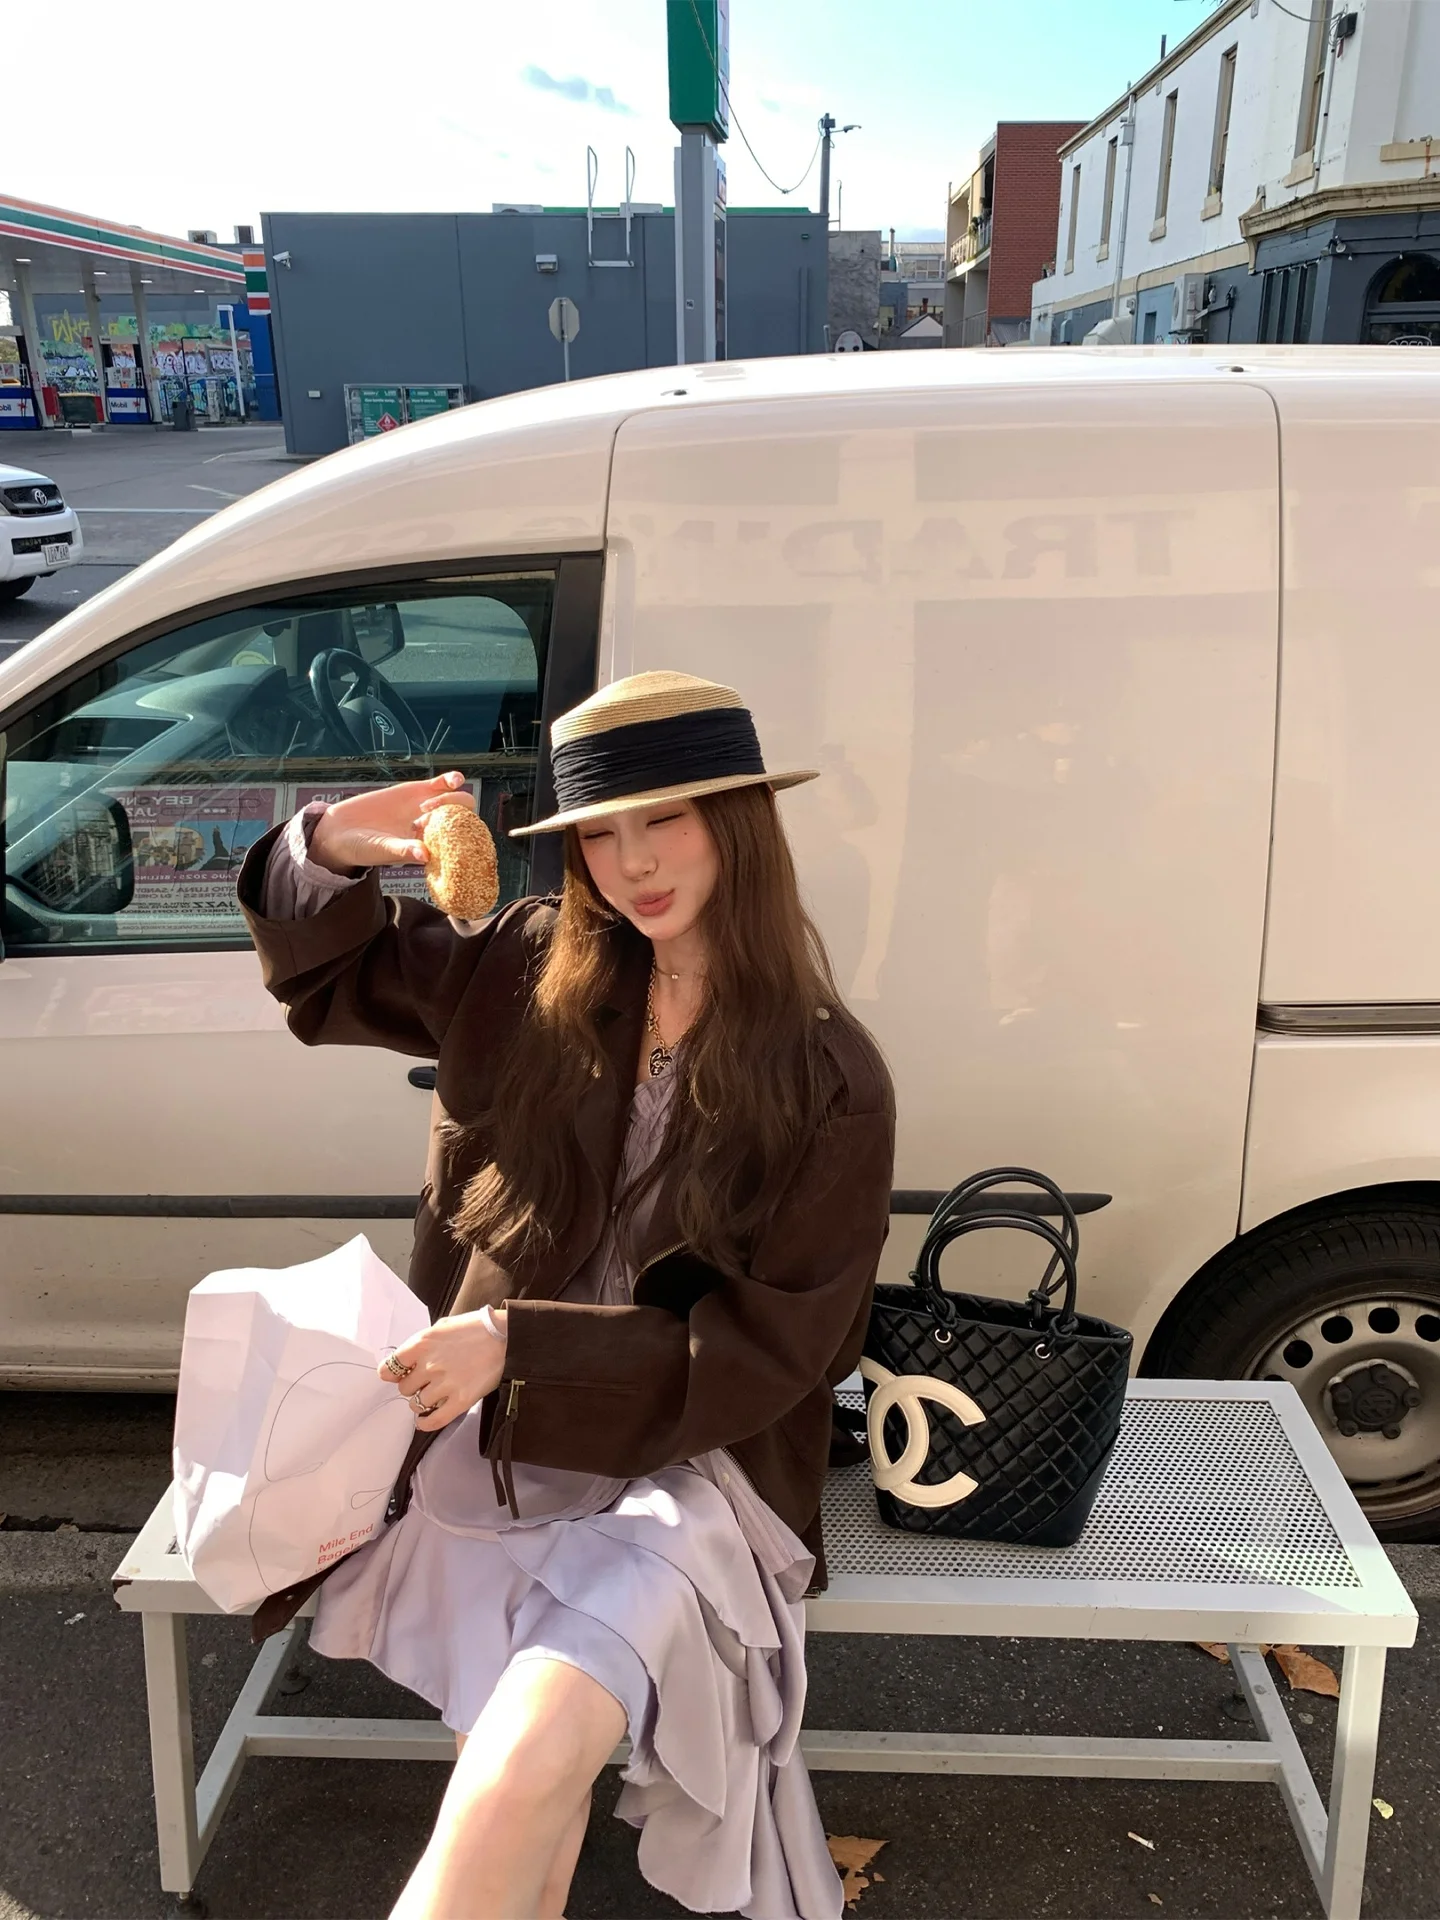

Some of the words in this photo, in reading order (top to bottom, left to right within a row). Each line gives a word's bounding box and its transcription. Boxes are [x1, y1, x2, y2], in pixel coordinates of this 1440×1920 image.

[0, 404, 12, 412] obil
[110, 401, 128, 409] Mobil
[319, 1537, 346, 1553] Mile
[350, 1523, 374, 1541] End
